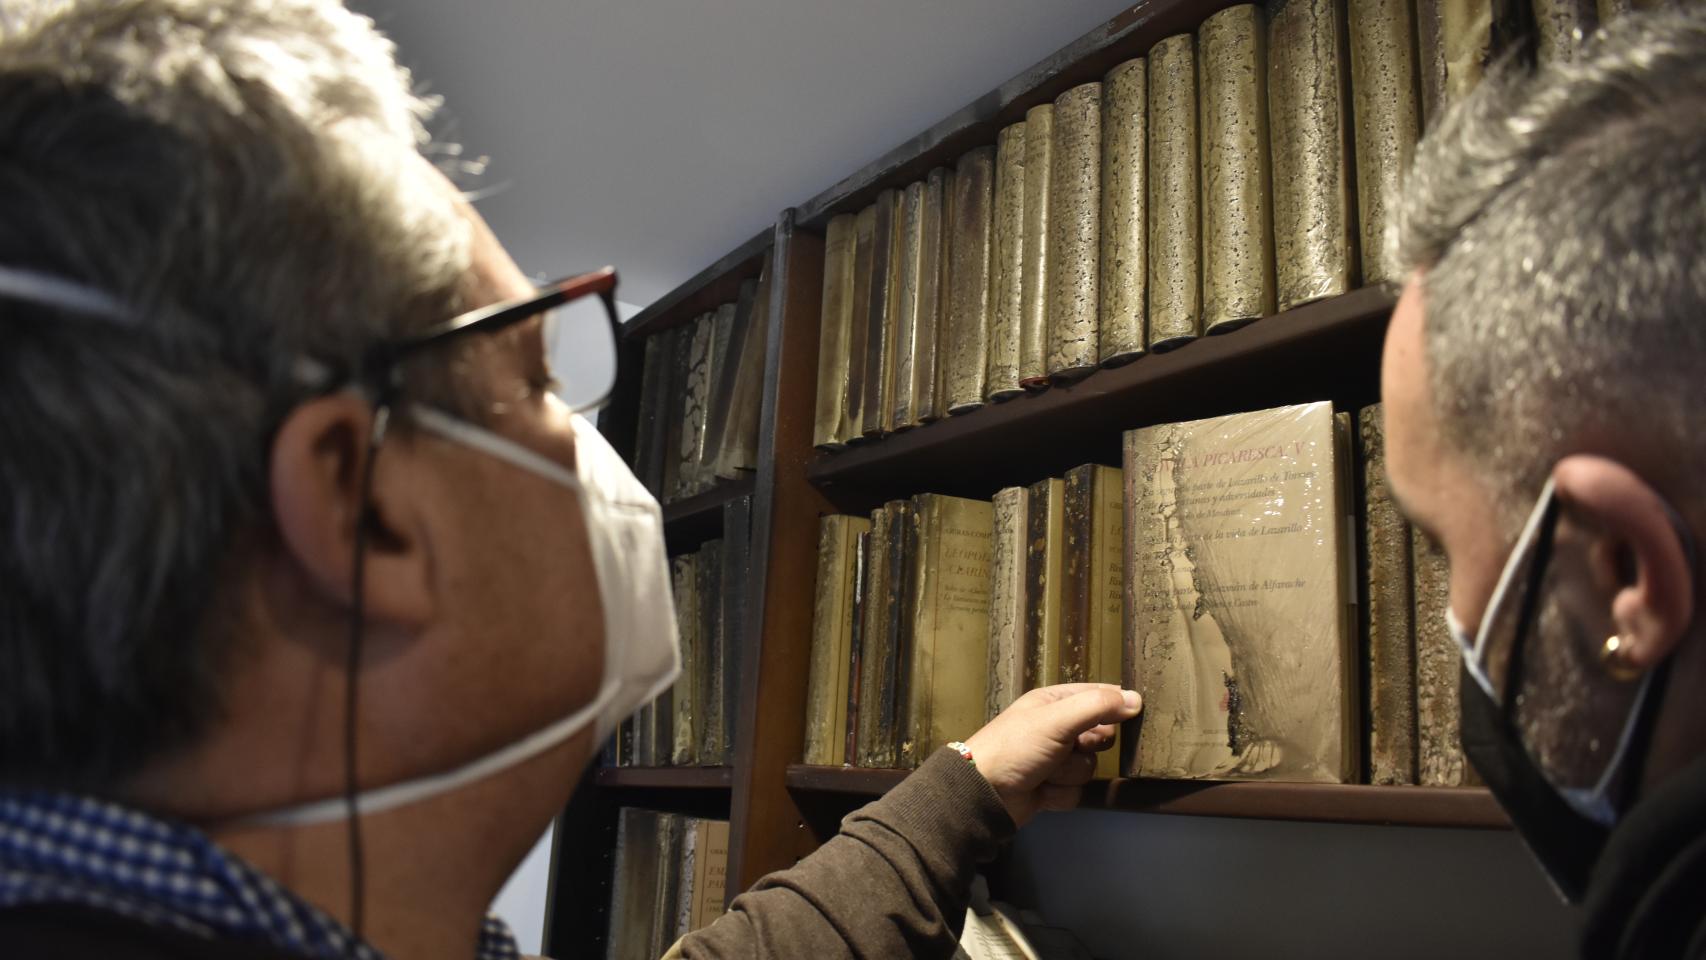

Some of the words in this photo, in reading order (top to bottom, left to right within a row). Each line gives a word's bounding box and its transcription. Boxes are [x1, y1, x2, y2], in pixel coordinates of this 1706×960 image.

[1295, 440, 1305, 456] V
[1228, 475, 1267, 488] Lazarillo
[1269, 472, 1281, 483] de
[1215, 529, 1224, 540] la
[1248, 525, 1259, 536] de
[1261, 522, 1304, 536] Lazarillo
